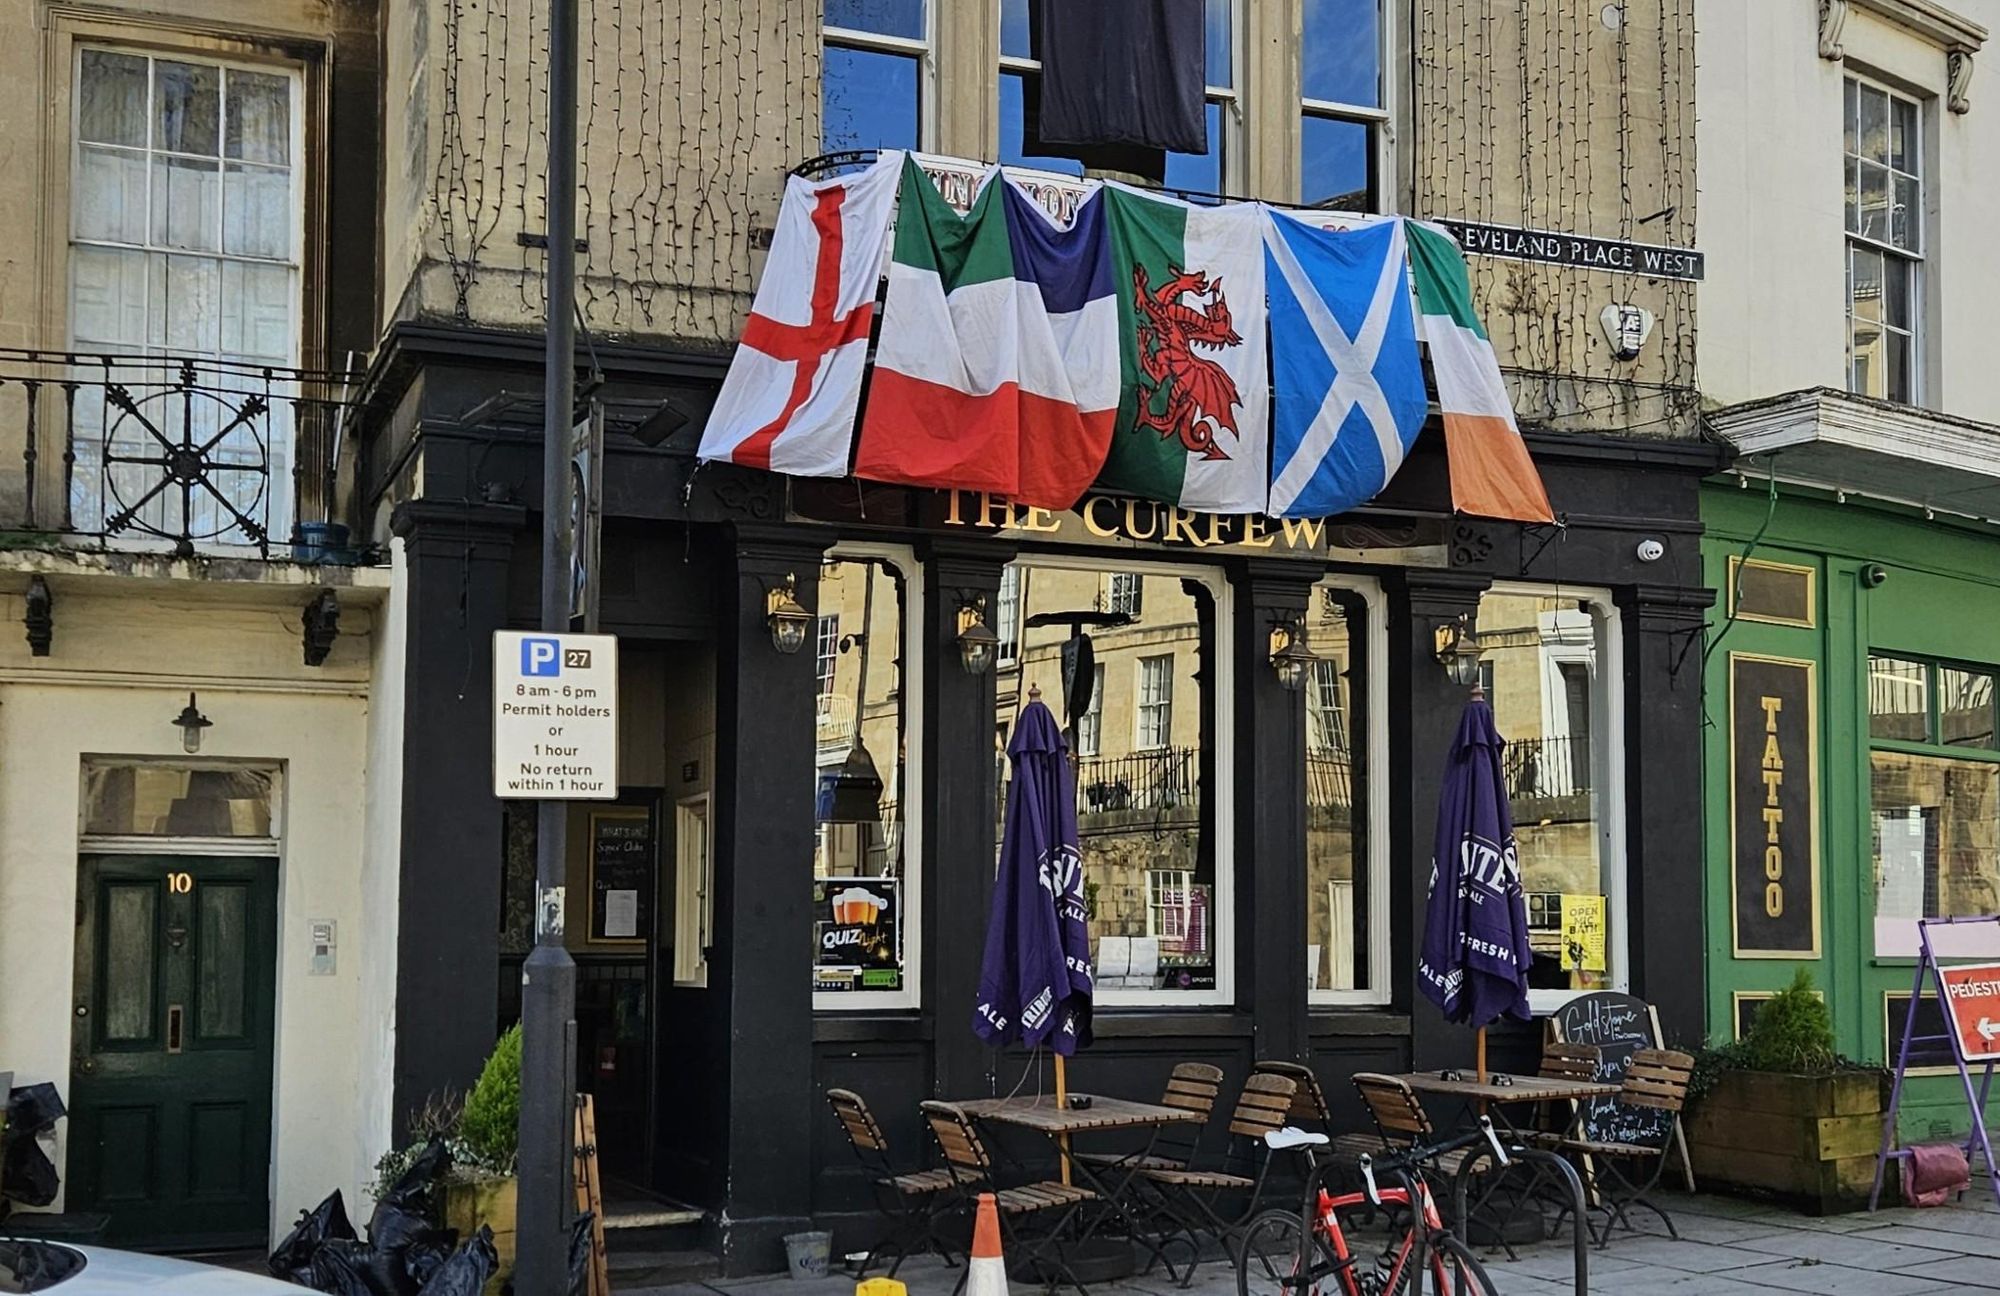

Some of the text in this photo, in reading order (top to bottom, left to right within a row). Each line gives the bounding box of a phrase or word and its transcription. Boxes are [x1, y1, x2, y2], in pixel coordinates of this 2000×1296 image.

[1465, 227, 1697, 275] EVELAND PLACE WEST
[1083, 495, 1326, 550] CURFEW
[568, 652, 588, 667] 27
[516, 684, 525, 696] 8
[529, 686, 551, 697] am
[562, 685, 571, 697] 6
[575, 687, 597, 700] pm
[502, 703, 611, 717] Permit holders
[548, 726, 564, 736] or
[534, 744, 579, 757] 1 hour
[520, 763, 592, 776] No return
[508, 779, 604, 791] within 1 hour
[1761, 696, 1784, 918] TATTOO
[167, 872, 192, 894] 10
[1569, 907, 1598, 917] OPEN
[1574, 916, 1594, 926] MIC
[822, 928, 862, 949] QUIZ
[1067, 955, 1092, 979] RES
[1420, 964, 1445, 988] ALE
[1948, 980, 2000, 999] PEDEST
[977, 1002, 1008, 1031] ALE
